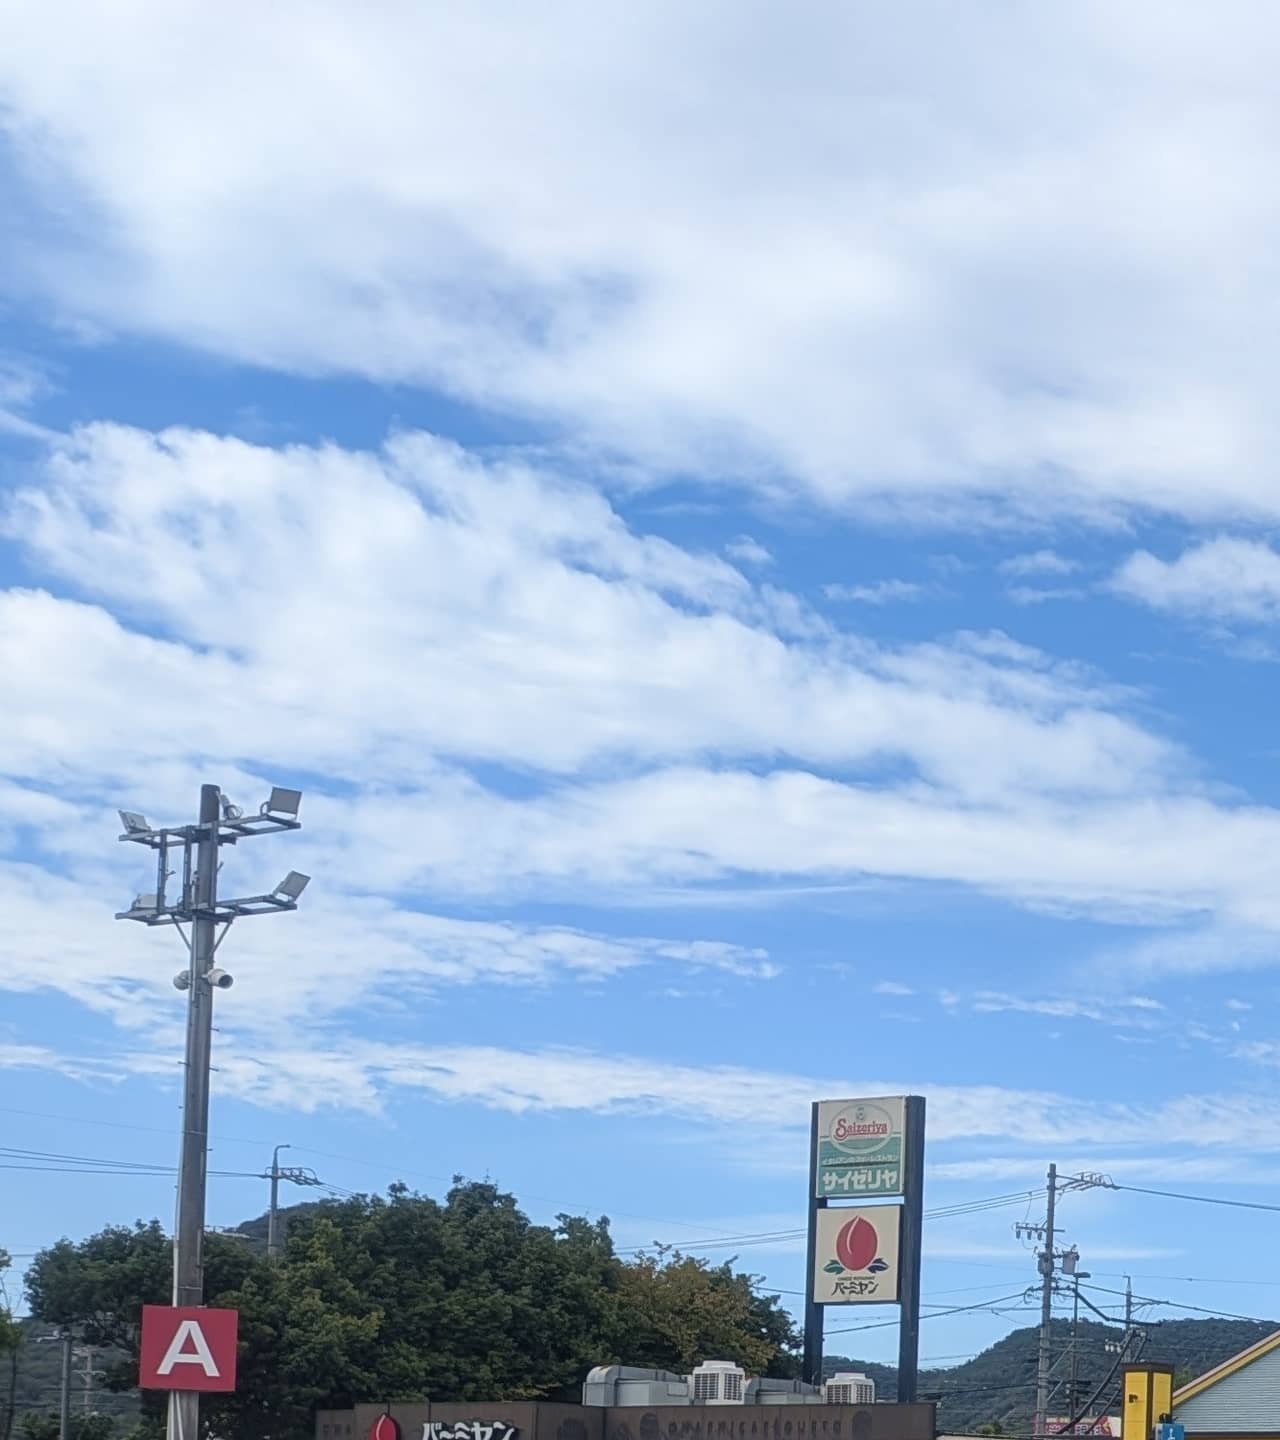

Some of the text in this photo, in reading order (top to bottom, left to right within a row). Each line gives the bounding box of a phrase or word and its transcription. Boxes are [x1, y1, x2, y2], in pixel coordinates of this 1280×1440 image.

[833, 1118, 888, 1141] Saizeriya
[822, 1169, 898, 1191] サイゼリヤ
[831, 1281, 879, 1296] バーミヤン
[156, 1320, 220, 1377] A
